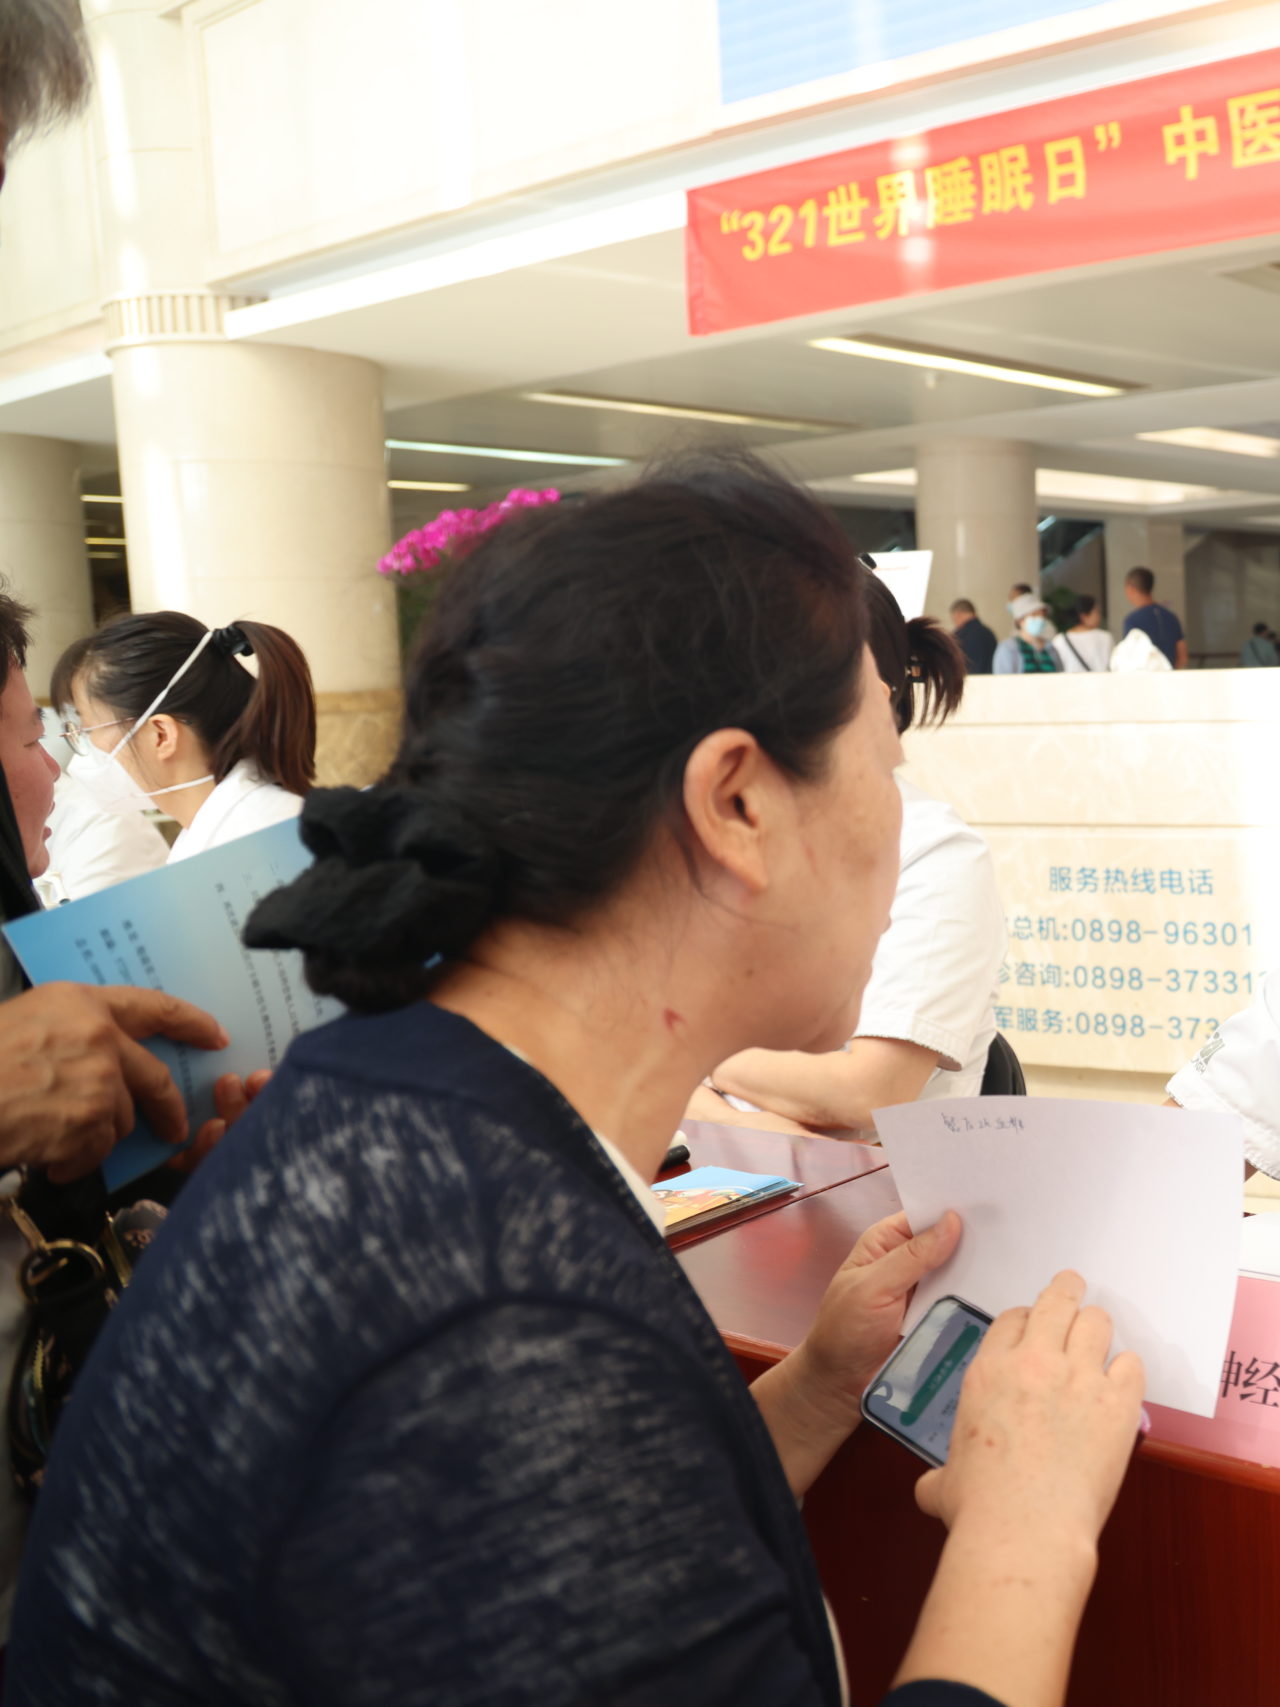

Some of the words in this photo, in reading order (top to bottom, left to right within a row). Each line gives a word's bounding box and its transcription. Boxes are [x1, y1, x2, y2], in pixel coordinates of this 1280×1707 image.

[1048, 866, 1215, 896] 服务热线电话
[1005, 916, 1253, 947] 总机:0898-96301
[998, 961, 1267, 995] 咨询:0898-37331
